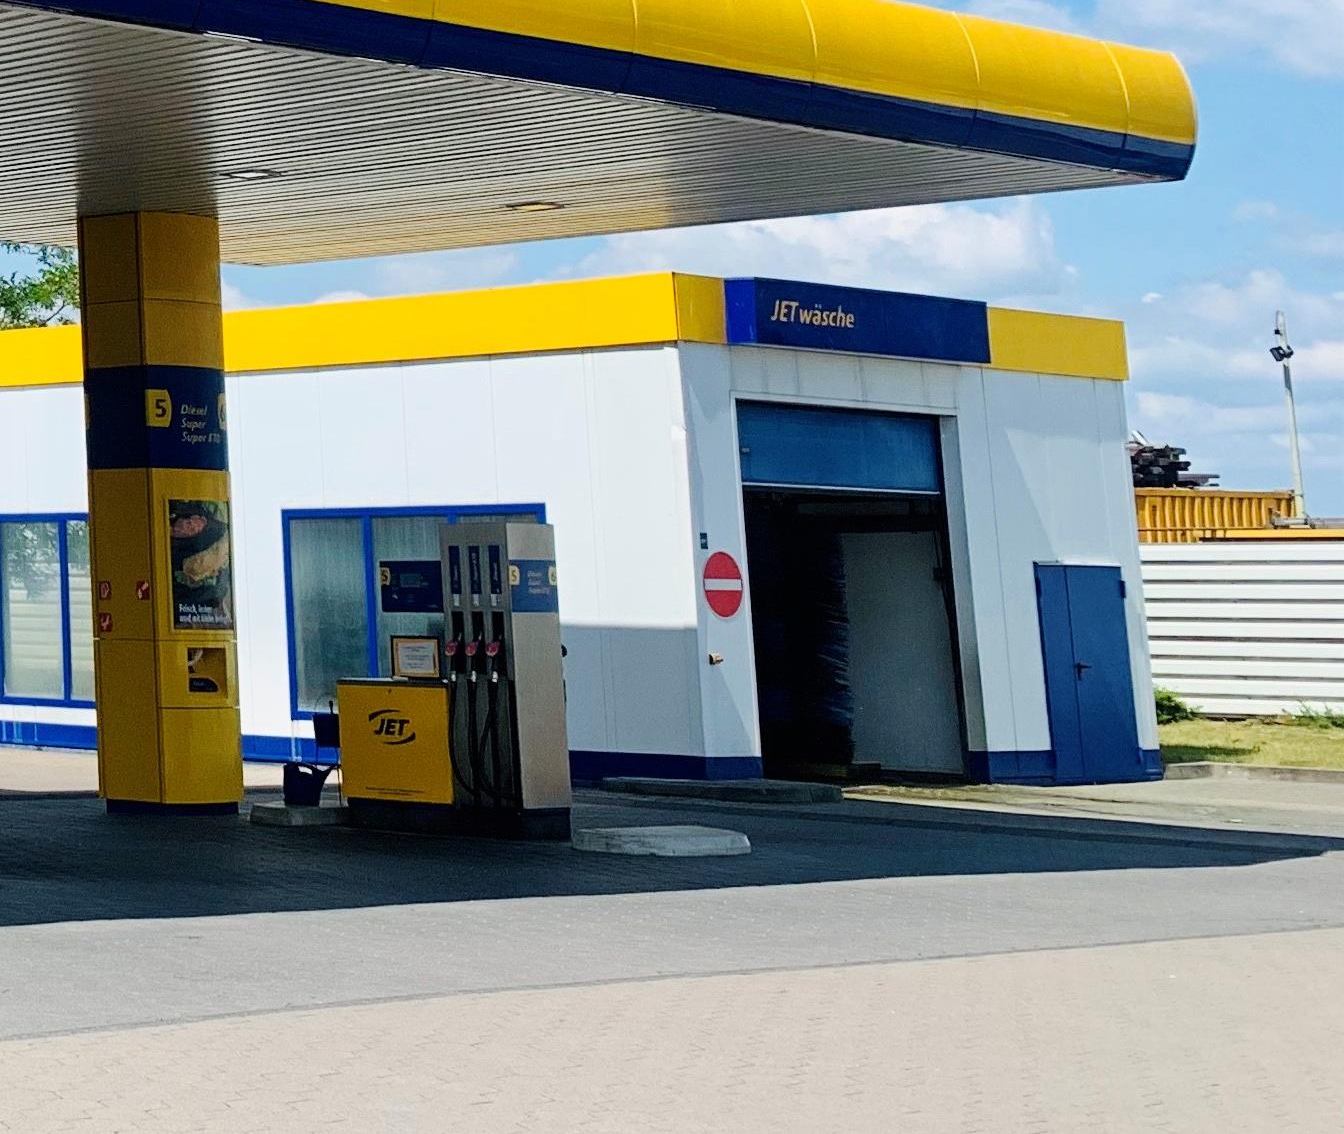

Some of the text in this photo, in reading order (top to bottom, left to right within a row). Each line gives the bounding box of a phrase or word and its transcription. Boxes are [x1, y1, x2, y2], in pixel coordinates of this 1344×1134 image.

[155, 399, 166, 417] 5
[180, 404, 208, 415] Diesel
[181, 417, 207, 431] Super
[181, 431, 207, 444] Super
[374, 718, 410, 736] JET
